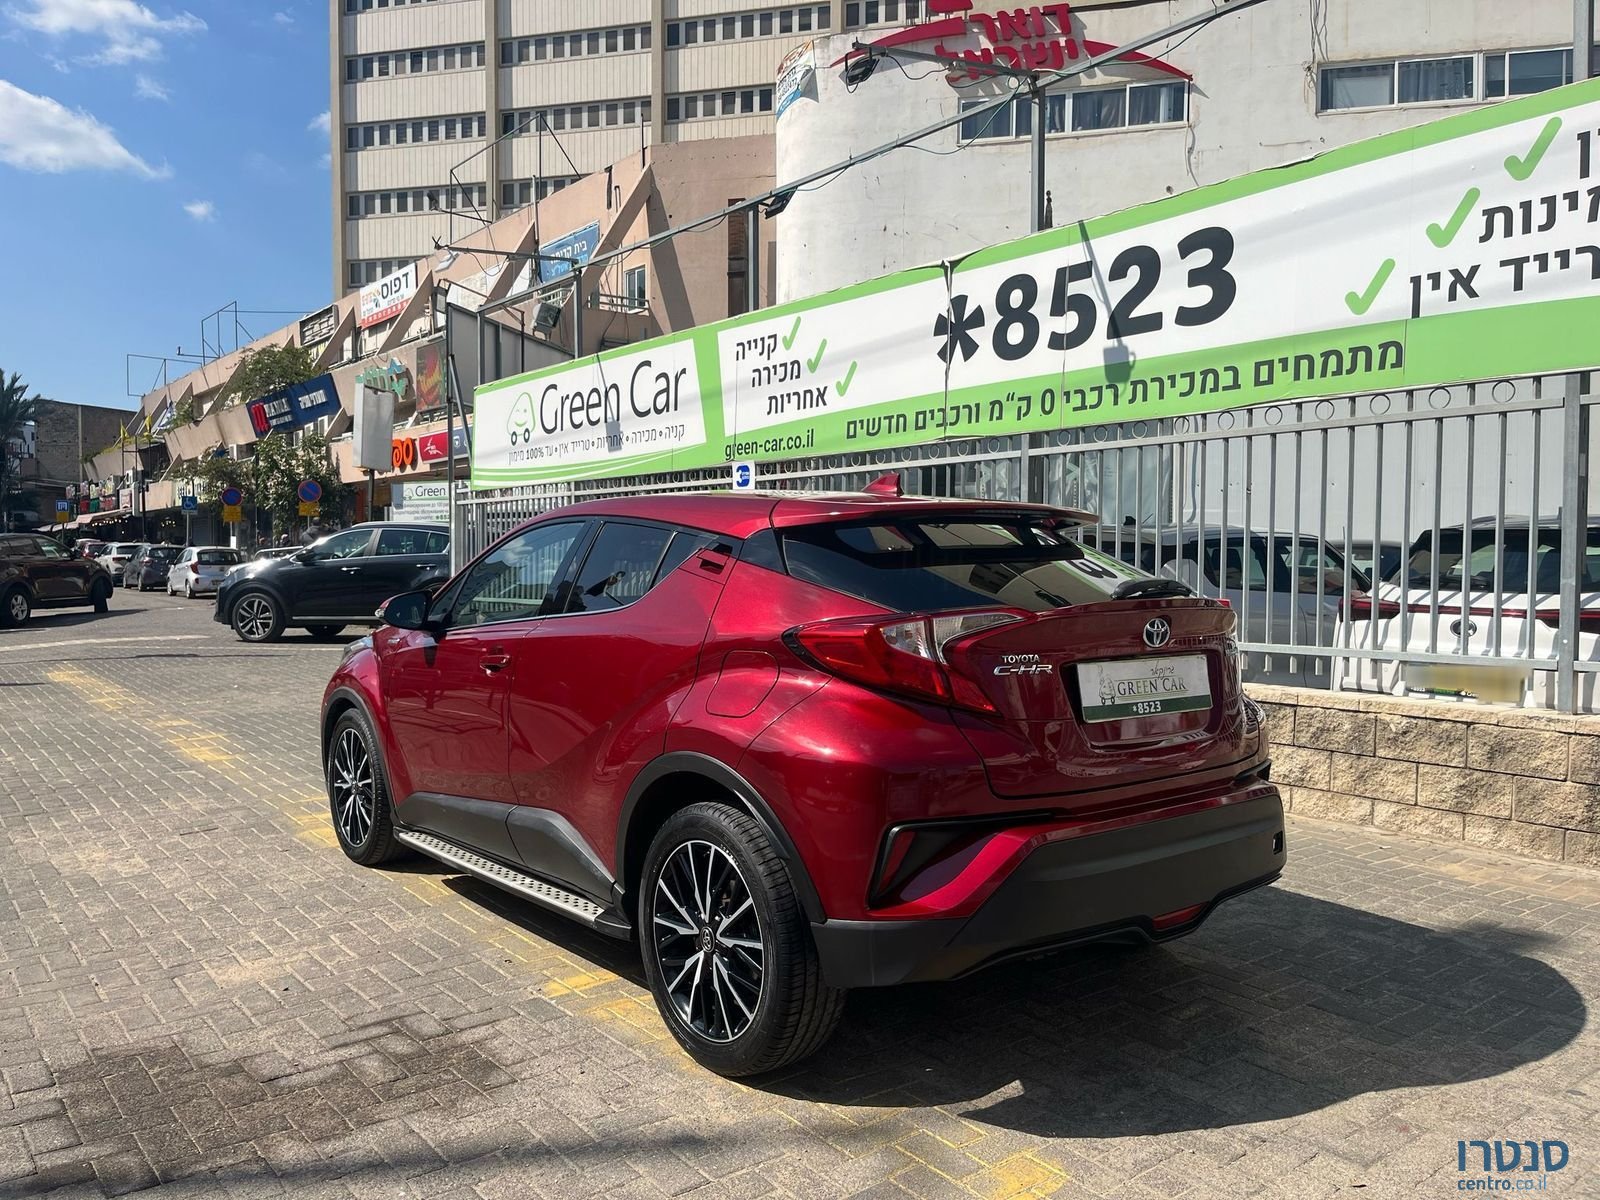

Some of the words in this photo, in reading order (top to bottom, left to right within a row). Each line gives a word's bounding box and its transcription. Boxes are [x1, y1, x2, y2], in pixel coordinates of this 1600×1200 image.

[969, 3, 1071, 43] דואר
[574, 240, 588, 254] בית
[381, 271, 410, 300] דפוס
[1409, 263, 1482, 320] אין
[735, 333, 778, 361] קנייה
[751, 359, 802, 388] מכירה
[1253, 340, 1404, 388] מתמחים
[540, 383, 621, 435] Green
[629, 360, 687, 418] Car
[1063, 383, 1120, 412] רכבי
[1127, 365, 1242, 405] במכירת
[766, 386, 829, 416] אחריות
[1040, 388, 1056, 416] 0
[845, 412, 908, 440] חדשים
[914, 401, 981, 431] ורכבים
[570, 438, 590, 453] טרייד
[596, 431, 625, 449] אחריות
[631, 429, 658, 444] מכירה
[664, 424, 686, 442] קניה
[724, 428, 815, 461] green-car.co.il
[507, 449, 525, 466] מימון
[525, 446, 544, 460] 100%
[545, 445, 554, 458] עד
[558, 442, 569, 459] אין
[415, 485, 446, 497] Green
[993, 664, 1054, 677] C-HR
[1002, 654, 1041, 664] TOYOTA
[1117, 677, 1159, 697] GREEN
[1162, 677, 1187, 692] CAR
